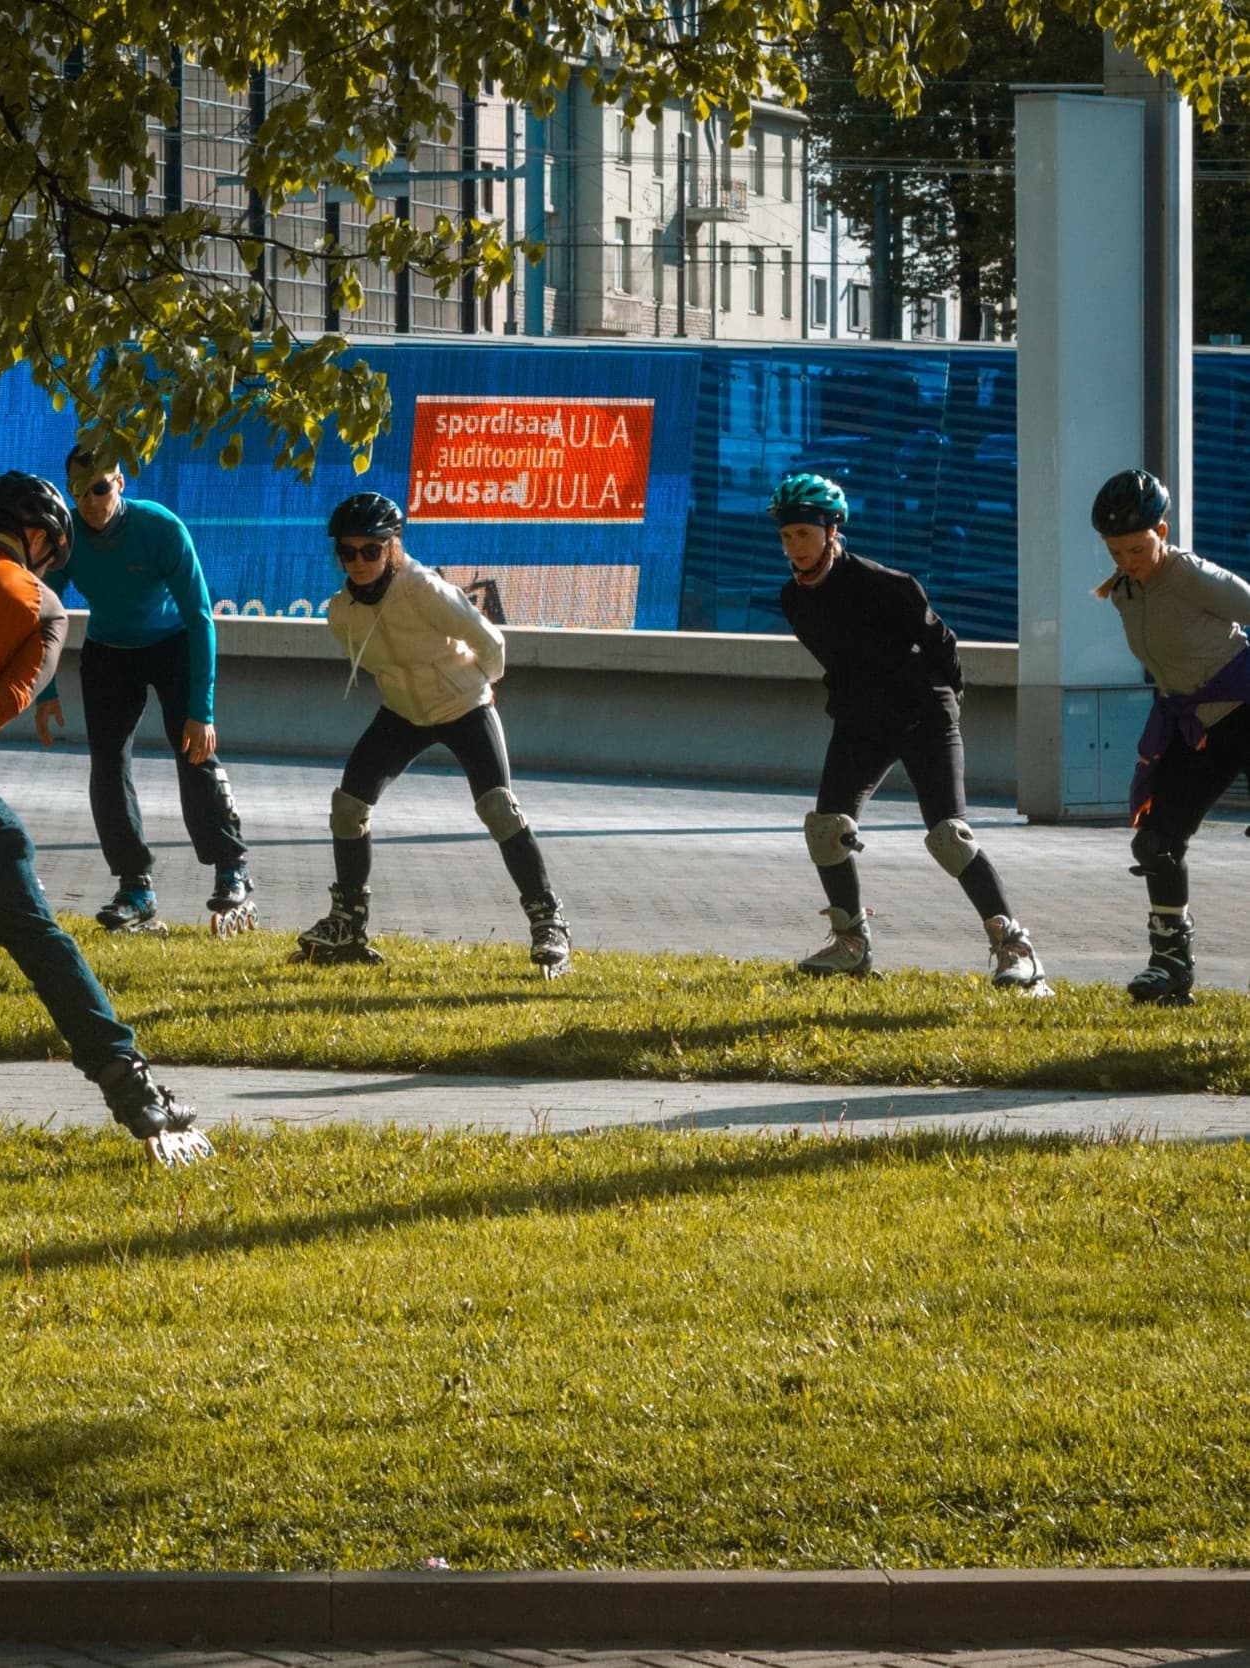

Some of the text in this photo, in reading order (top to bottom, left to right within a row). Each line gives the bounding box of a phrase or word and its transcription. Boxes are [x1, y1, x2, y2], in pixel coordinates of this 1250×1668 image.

[435, 407, 630, 449] spordisaal AULA
[437, 440, 565, 469] auditoorium
[409, 470, 530, 513] jõusaal
[518, 472, 621, 510] UJULA
